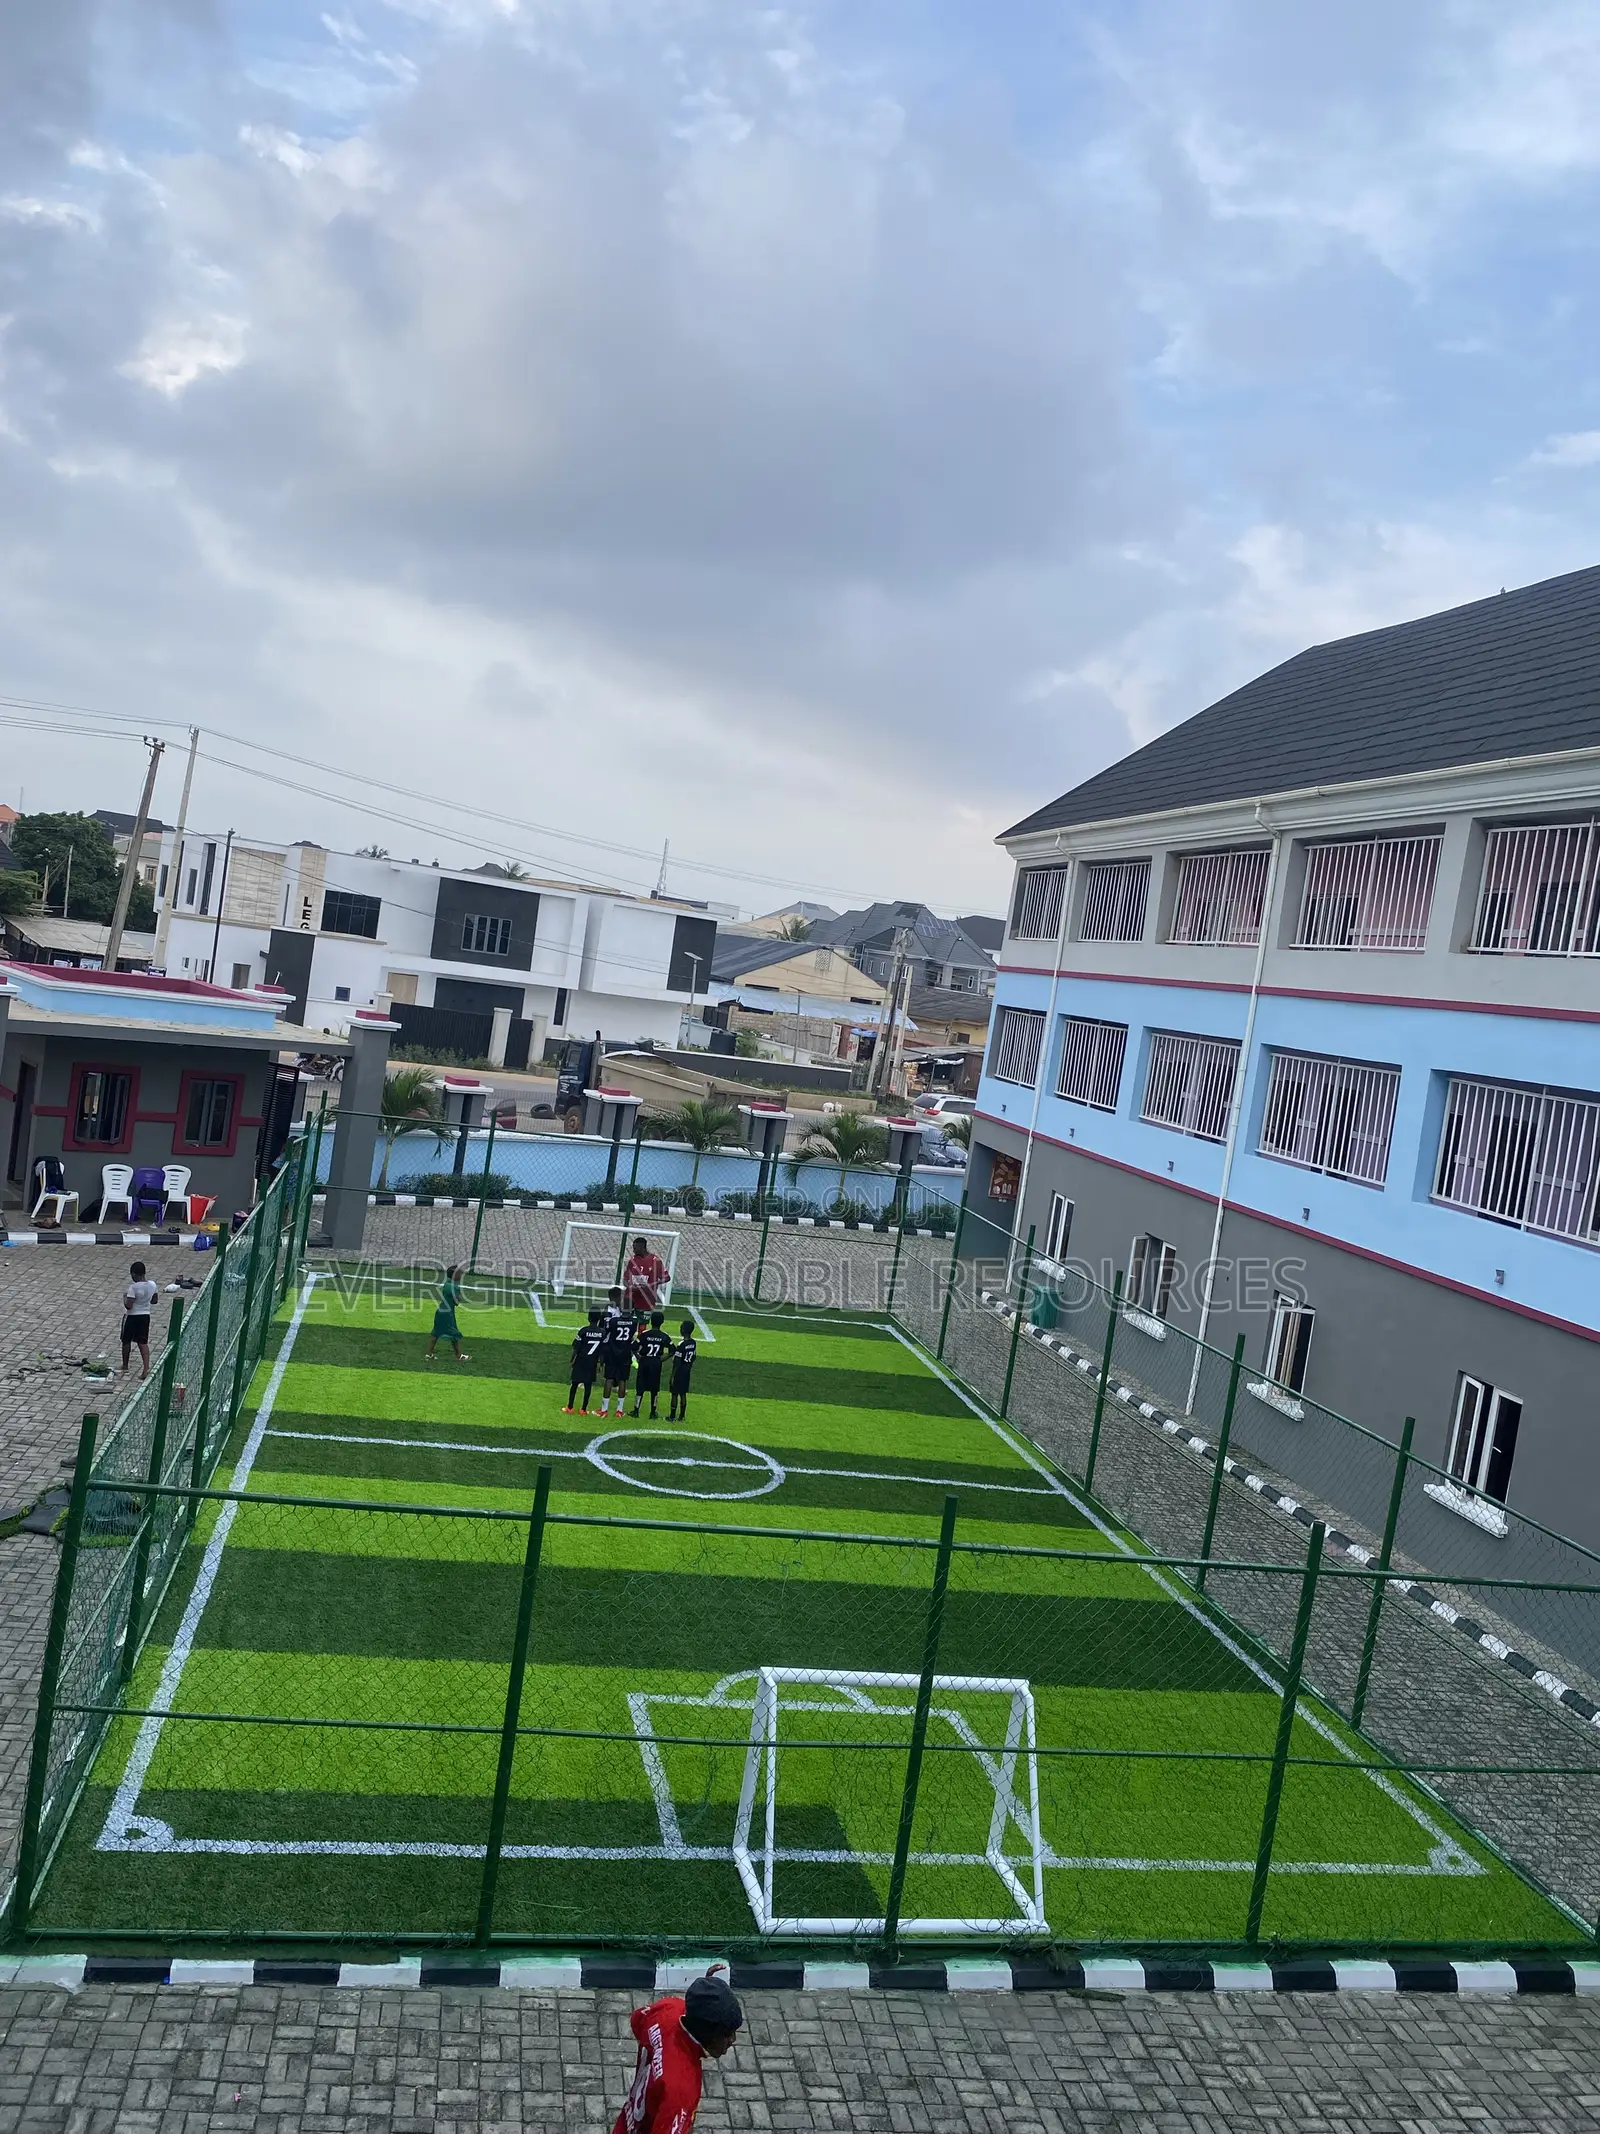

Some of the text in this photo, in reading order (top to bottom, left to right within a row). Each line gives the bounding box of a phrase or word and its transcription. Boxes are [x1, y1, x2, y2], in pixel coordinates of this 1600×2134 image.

[616, 1327, 630, 1341] 23
[587, 1340, 601, 1356] 7
[646, 1343, 661, 1358] 27
